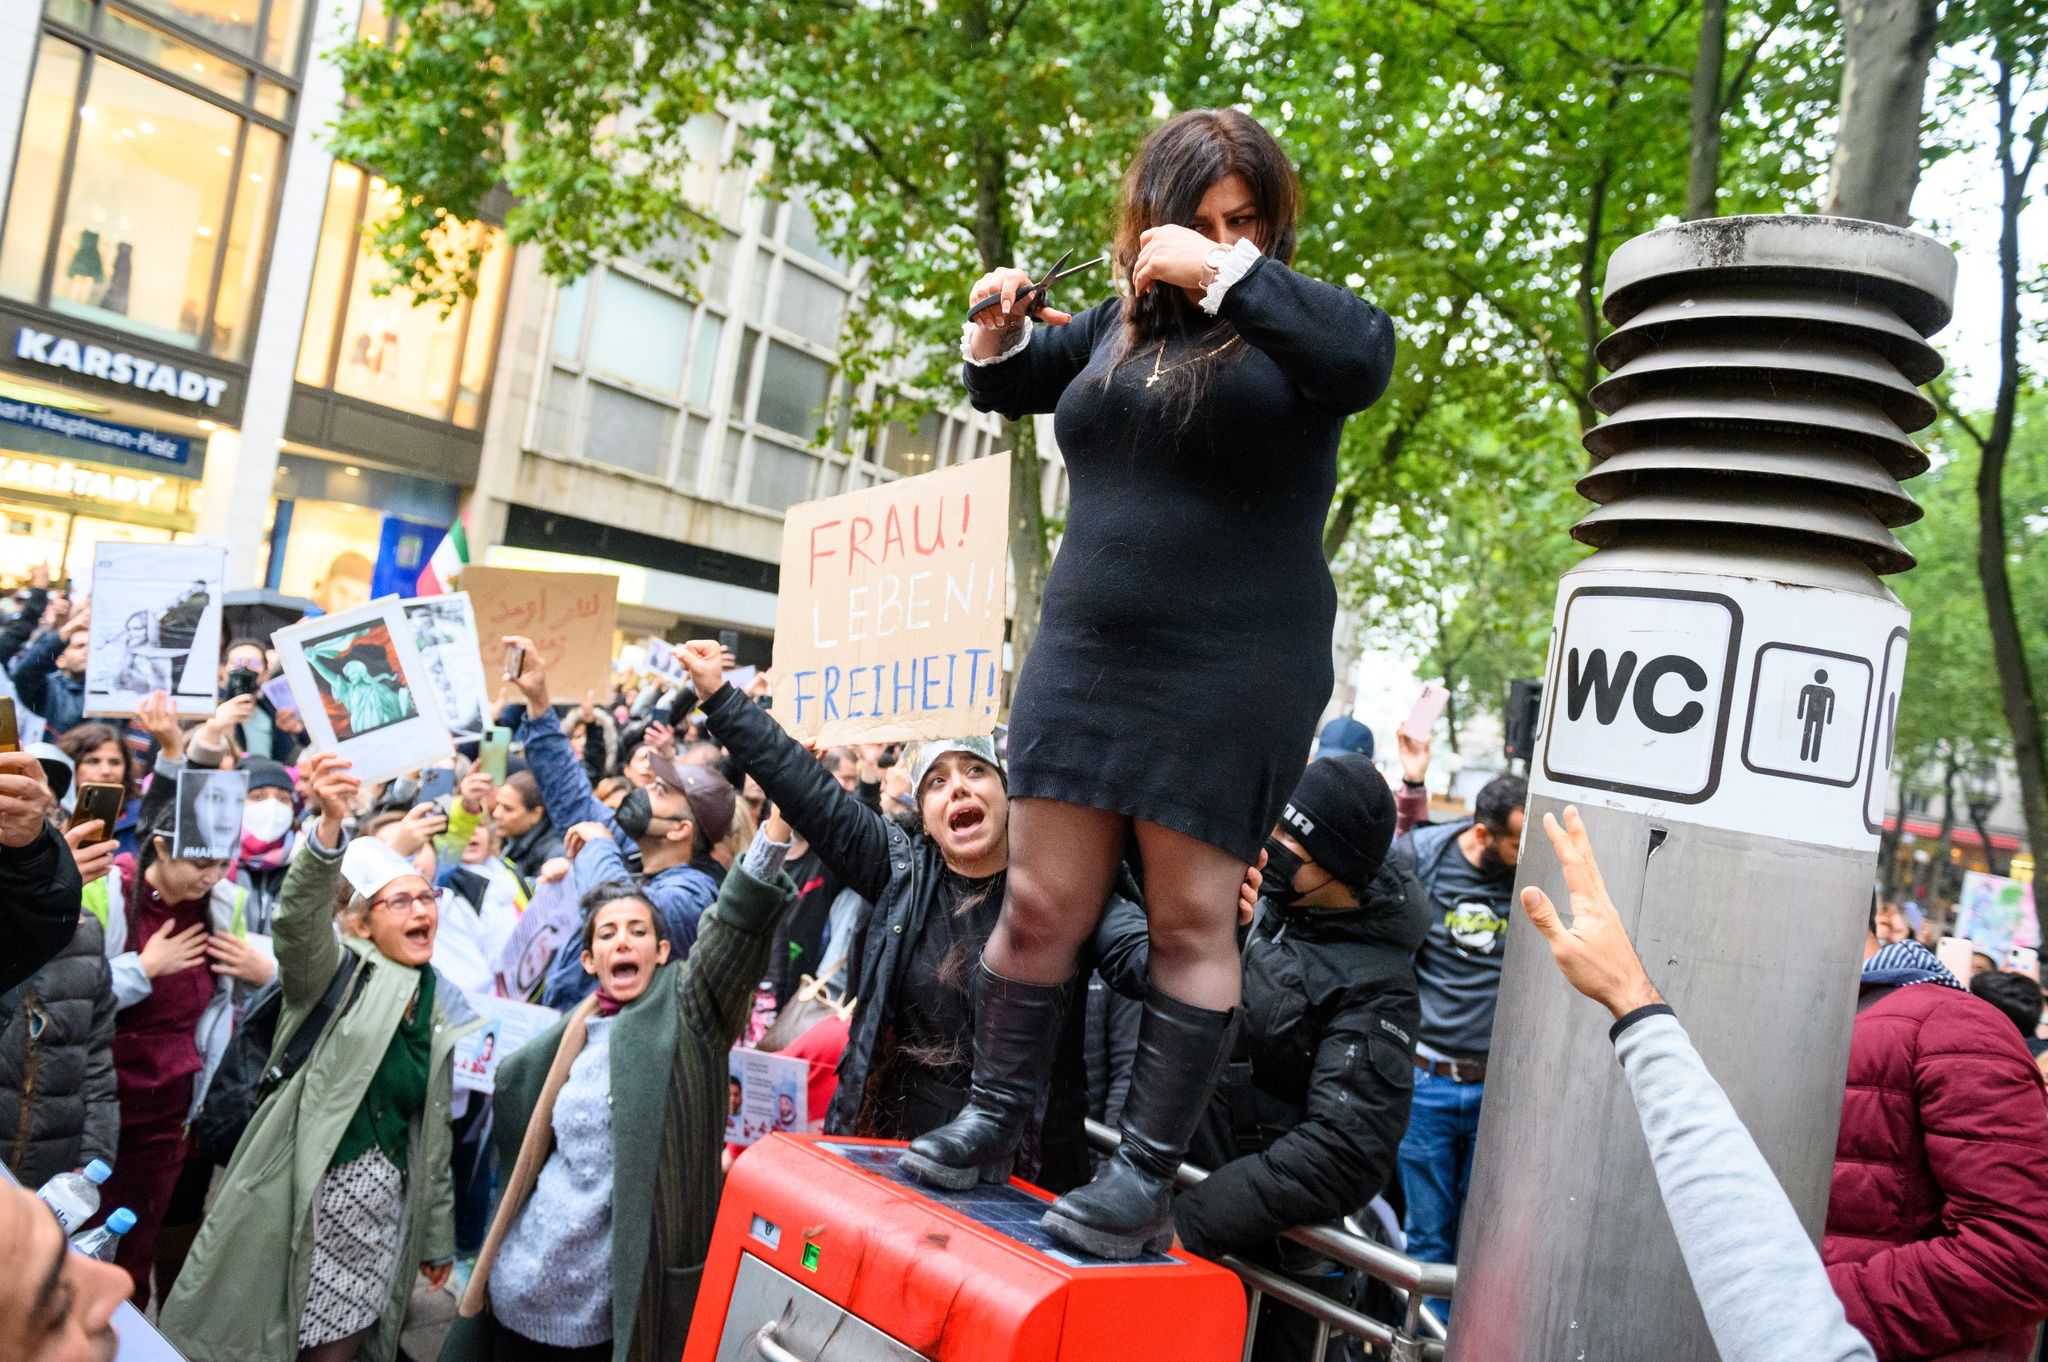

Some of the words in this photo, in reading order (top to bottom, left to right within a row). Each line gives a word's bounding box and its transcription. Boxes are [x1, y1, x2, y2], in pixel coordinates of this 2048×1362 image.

[17, 327, 228, 408] KARSTADT
[809, 493, 971, 590] FRAU!
[811, 562, 996, 649] LEBEN!
[794, 648, 996, 725] FREIHEIT!
[1568, 647, 1708, 734] WC
